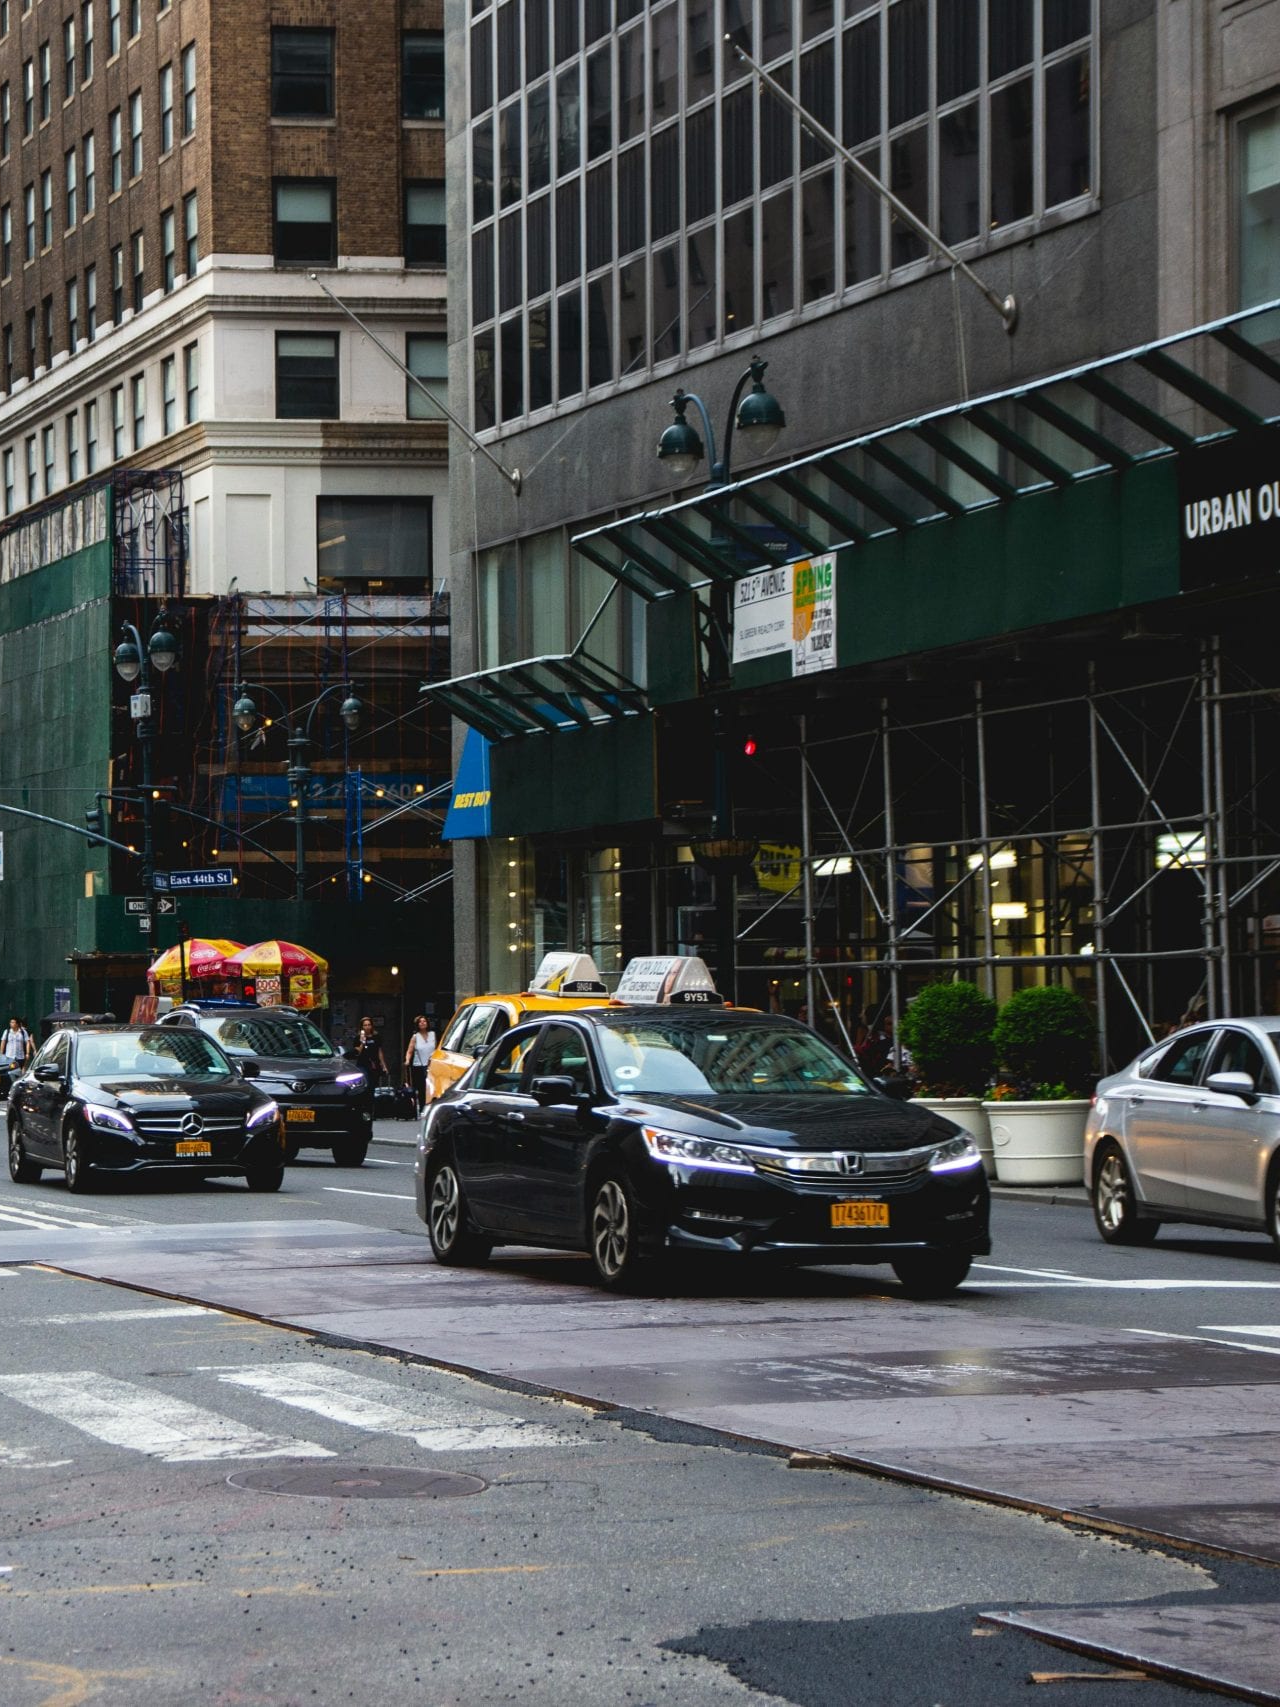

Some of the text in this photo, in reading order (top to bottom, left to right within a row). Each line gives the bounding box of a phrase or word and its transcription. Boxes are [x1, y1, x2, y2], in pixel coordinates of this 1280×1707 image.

[1185, 488, 1252, 539] URBAN
[761, 571, 786, 598] AVENUE
[453, 793, 473, 809] BEST
[170, 872, 228, 885] East 44th St
[684, 993, 709, 1003] 9Y51
[834, 1204, 884, 1221] T743617C
